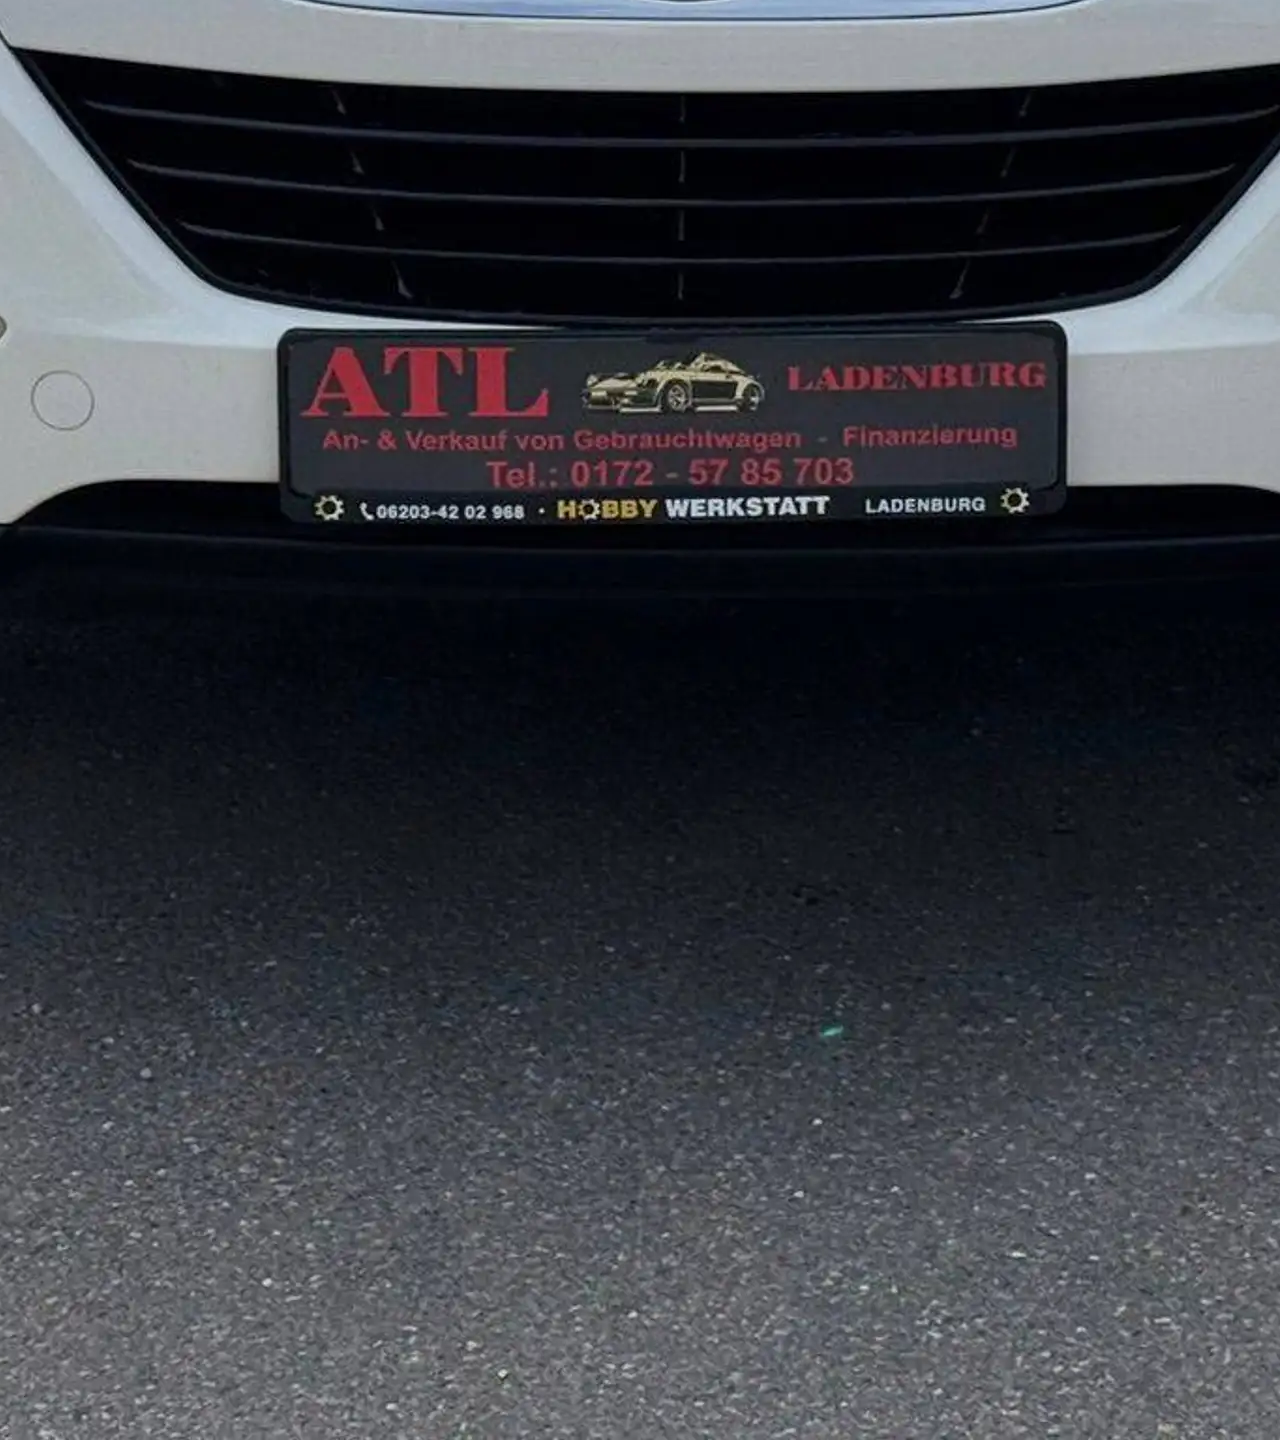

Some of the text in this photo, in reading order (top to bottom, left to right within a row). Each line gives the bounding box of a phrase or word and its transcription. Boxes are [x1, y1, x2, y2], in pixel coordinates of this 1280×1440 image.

[300, 346, 549, 417] ATL
[787, 361, 1048, 391] LADENBURG
[323, 430, 369, 450] An-
[376, 429, 398, 451] &
[406, 429, 508, 451] Verkauf
[514, 433, 565, 450] von
[574, 428, 801, 453] Gebrauchtwagen
[842, 424, 1018, 449] Finanzierung
[486, 460, 559, 489] Tel.:
[571, 460, 655, 487] 0172
[688, 459, 729, 486] 57
[740, 458, 783, 486] 85
[793, 457, 855, 486] 703
[376, 504, 459, 520] 06203-42
[464, 504, 489, 520] 02
[665, 495, 830, 518] WERKSTATT
[865, 496, 987, 514] LADENBURG
